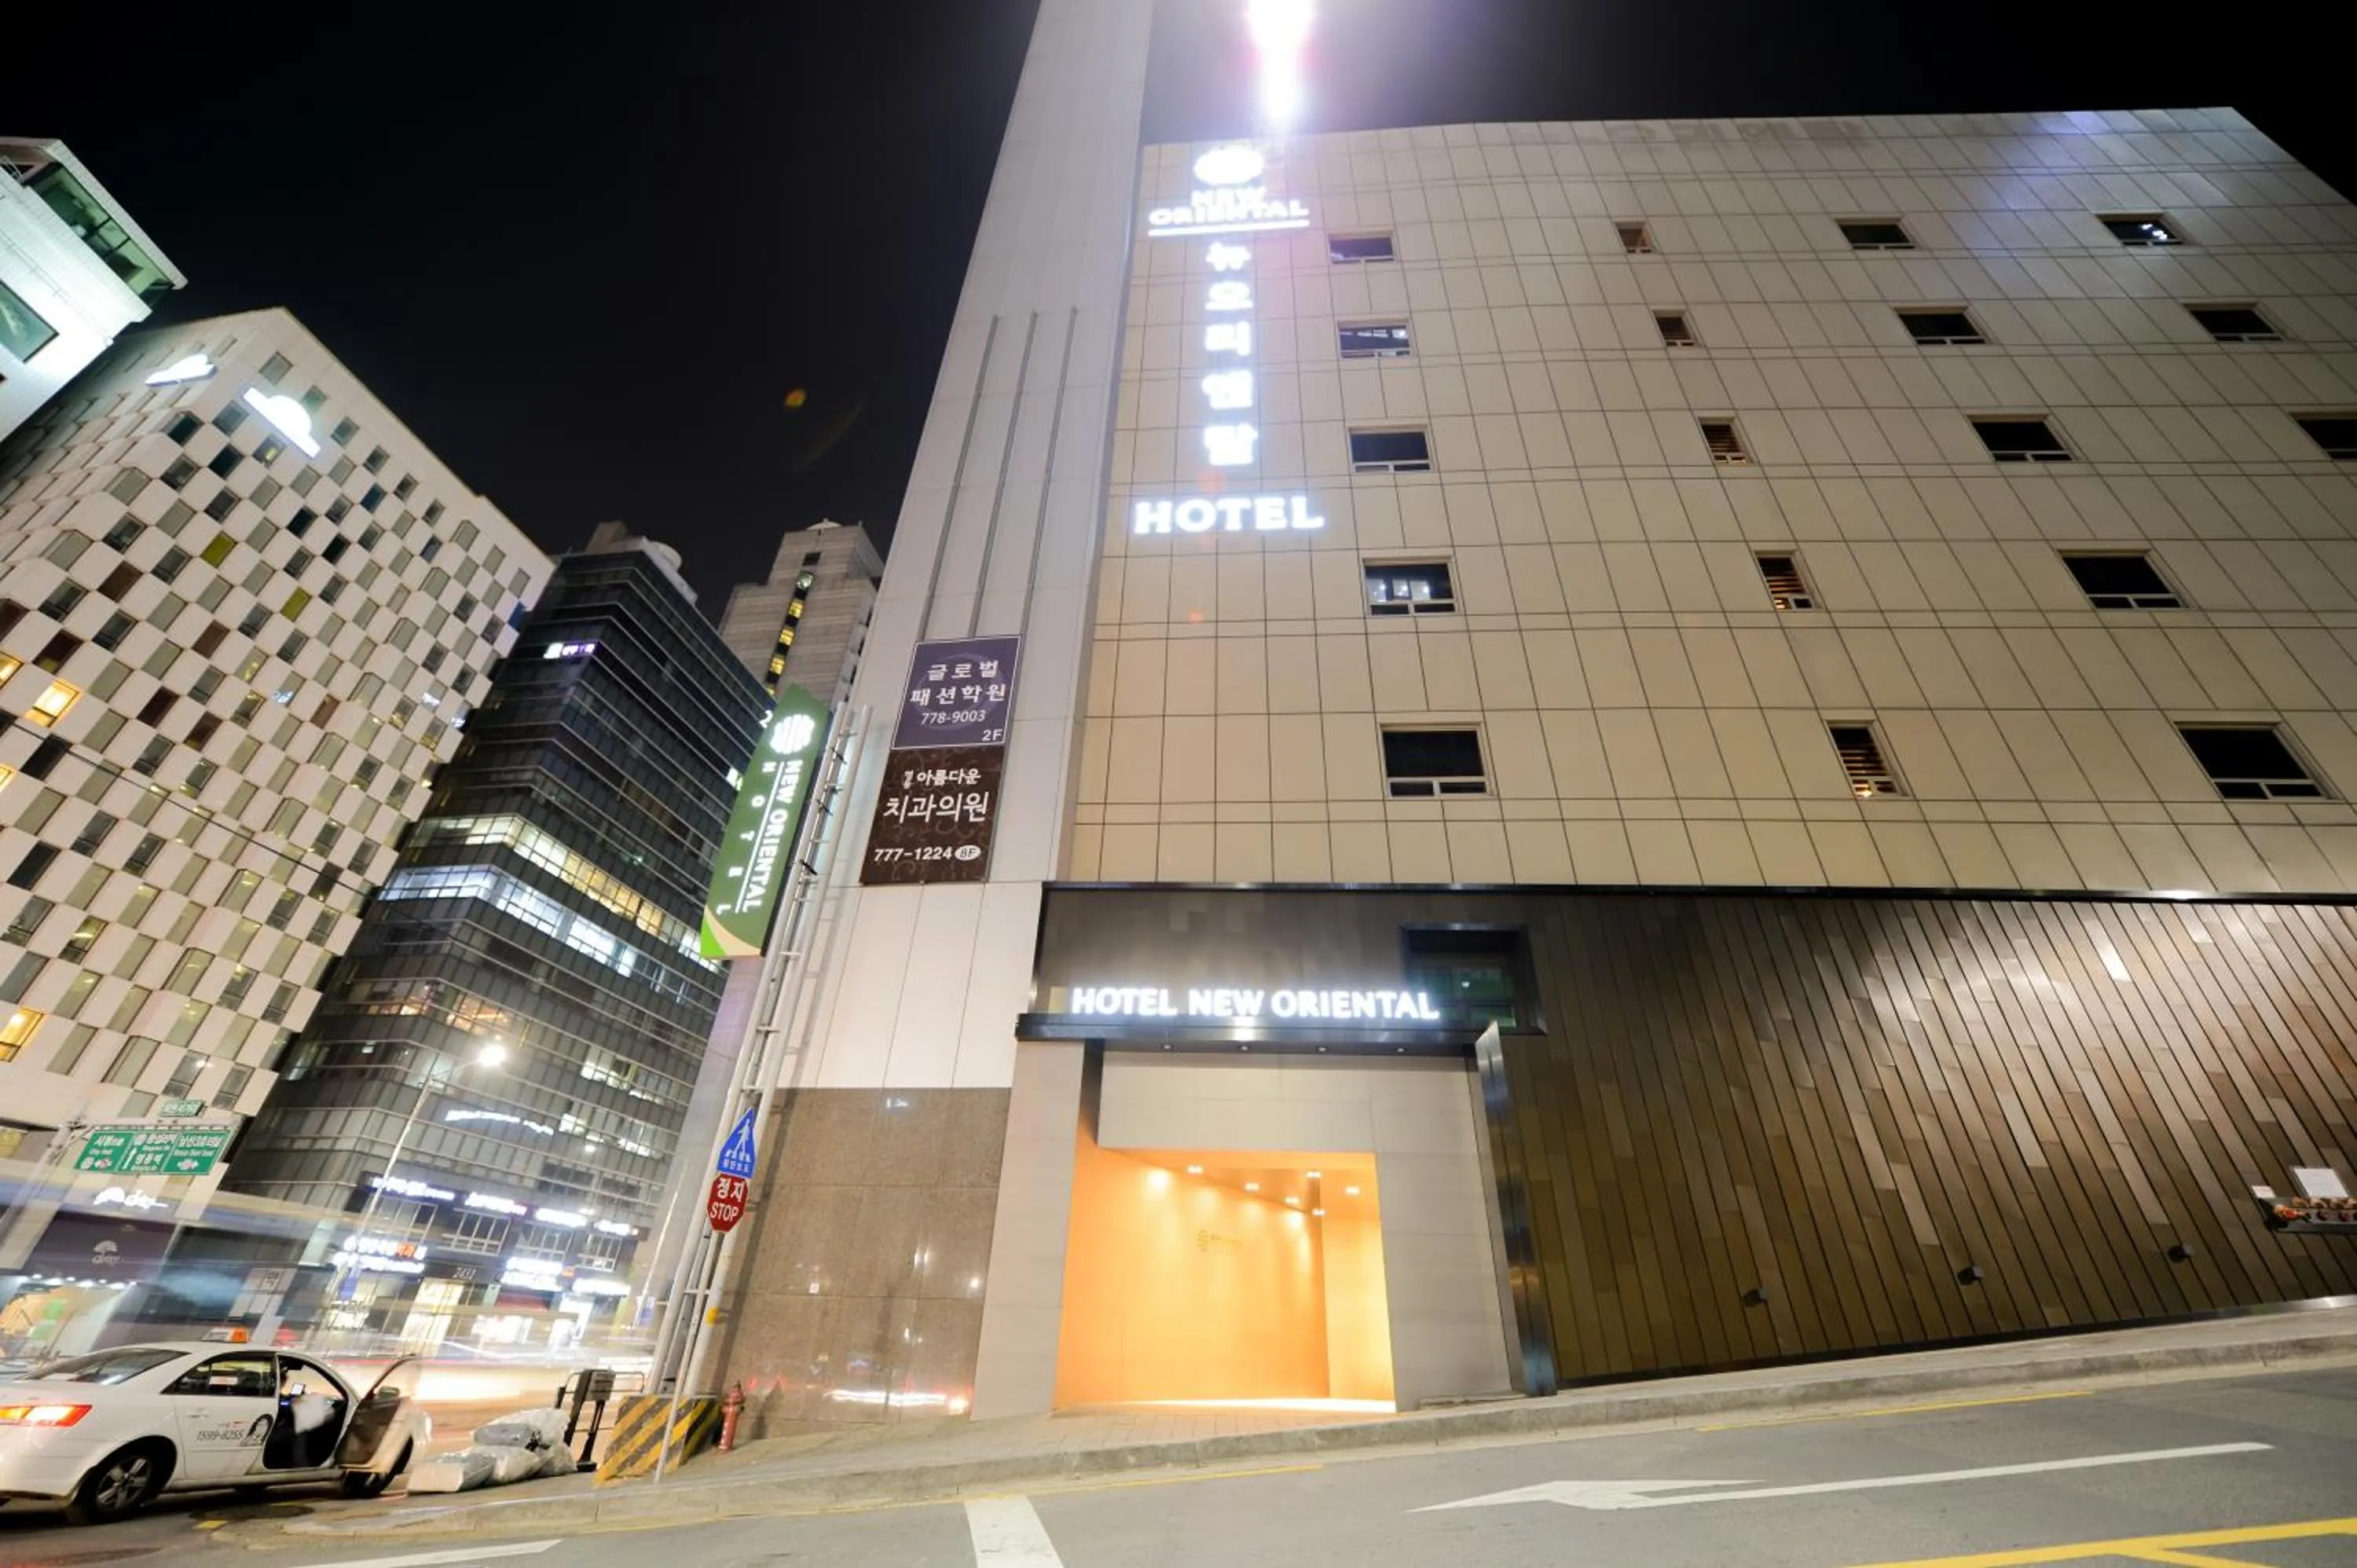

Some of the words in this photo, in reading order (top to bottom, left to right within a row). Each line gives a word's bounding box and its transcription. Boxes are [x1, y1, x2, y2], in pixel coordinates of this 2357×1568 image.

[1149, 200, 1310, 225] ORIENTAL
[1133, 496, 1325, 535] HOTEL
[927, 661, 999, 681] 글로벌
[910, 684, 1006, 705] 패션학원
[920, 710, 987, 725] 778-9003
[981, 728, 1003, 742] 2F
[775, 759, 804, 803] NEW
[917, 768, 981, 786] 아름다운
[882, 791, 990, 824] 치과의원
[742, 808, 788, 914] ORIENTAL
[874, 846, 953, 862] 777-1224
[1072, 987, 1177, 1015] HOTEL
[1188, 988, 1266, 1017] NEW
[1270, 990, 1440, 1020] ORIENTAL
[717, 1178, 745, 1203] 정지
[709, 1201, 739, 1222] STOP
